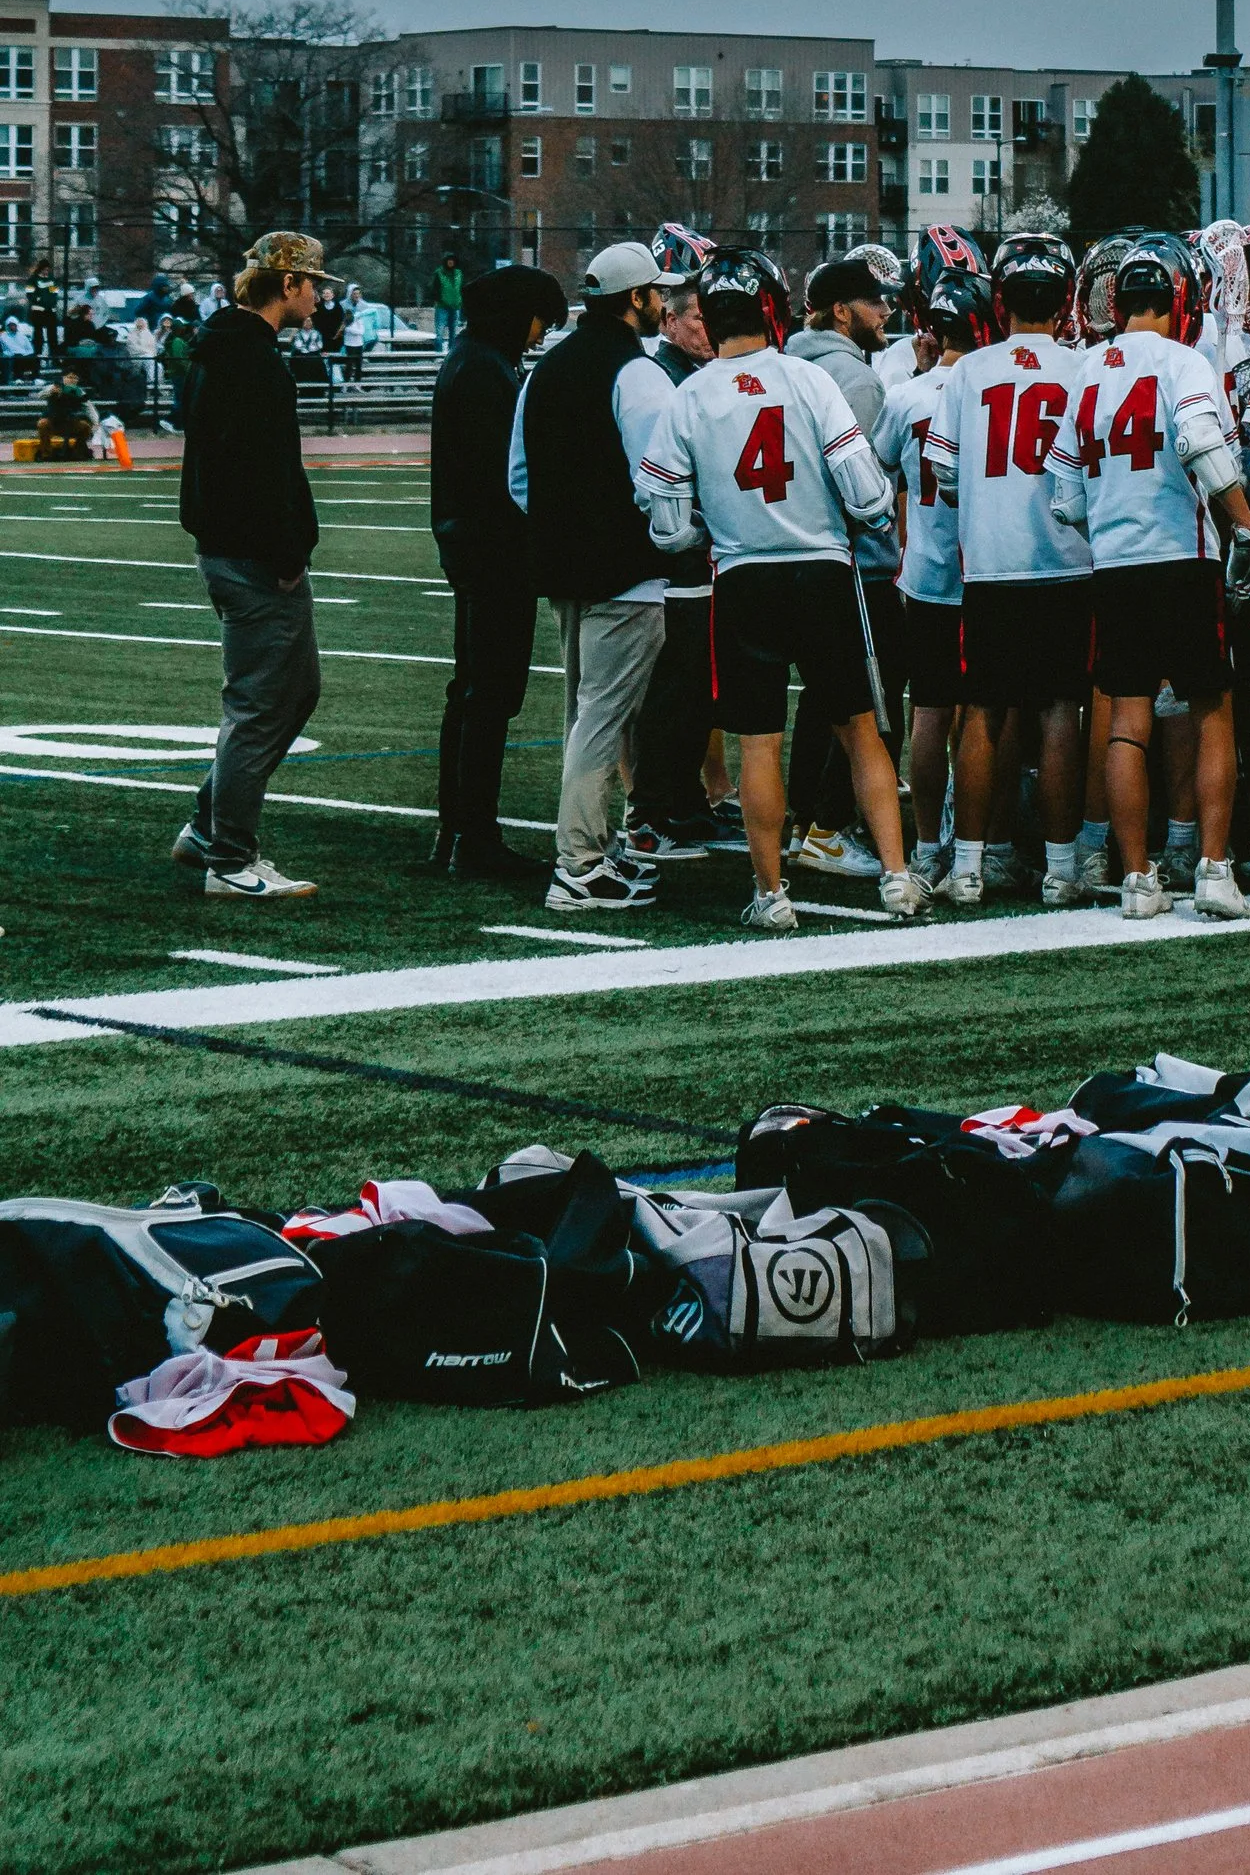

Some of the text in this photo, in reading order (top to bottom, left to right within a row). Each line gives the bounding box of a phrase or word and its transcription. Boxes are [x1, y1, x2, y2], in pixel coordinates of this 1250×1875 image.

[1014, 348, 1042, 370] EA
[733, 405, 795, 504] 4
[981, 382, 1069, 478] 16
[1075, 375, 1165, 479] 44
